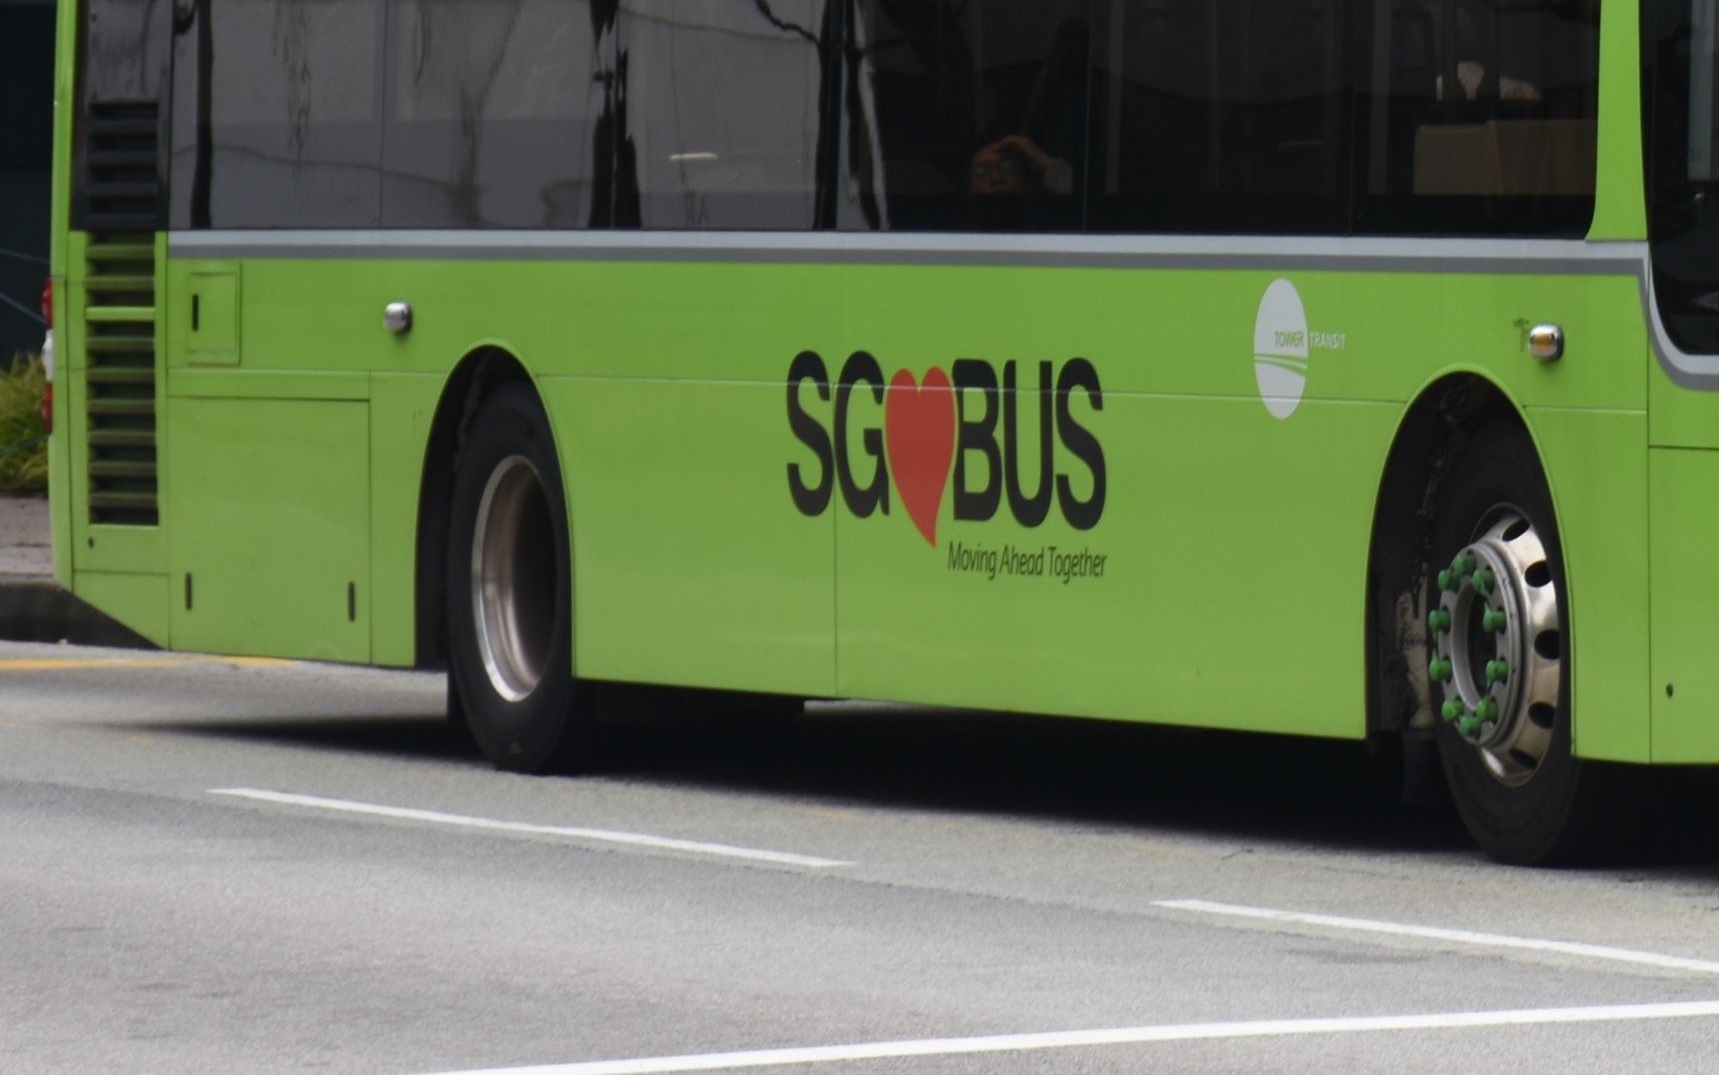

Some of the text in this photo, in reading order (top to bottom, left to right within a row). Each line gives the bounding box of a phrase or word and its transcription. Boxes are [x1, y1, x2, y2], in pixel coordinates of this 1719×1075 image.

[1274, 330, 1346, 349] TOWER TRANSIT
[947, 540, 1107, 585] Moving Ahead Together
